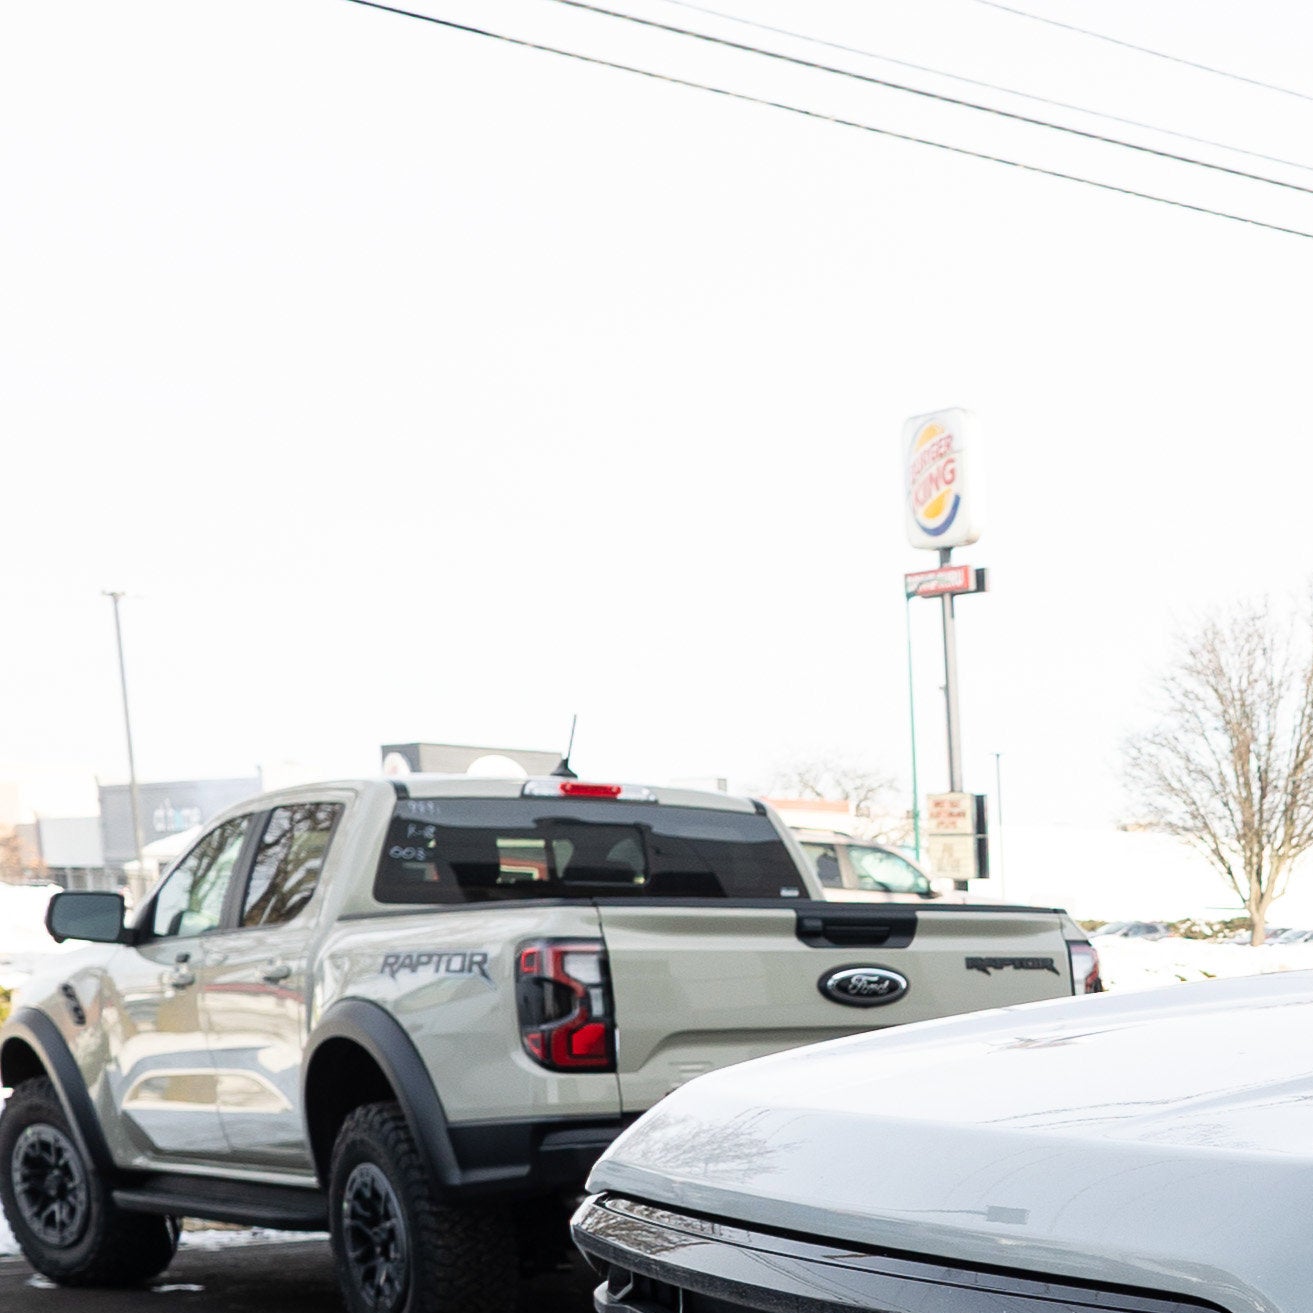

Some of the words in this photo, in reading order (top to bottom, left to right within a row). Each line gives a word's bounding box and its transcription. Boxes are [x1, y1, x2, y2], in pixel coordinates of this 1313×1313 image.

[380, 952, 497, 990] RAPTOR
[965, 956, 1060, 976] RAPTOR
[848, 973, 891, 995] Ford
